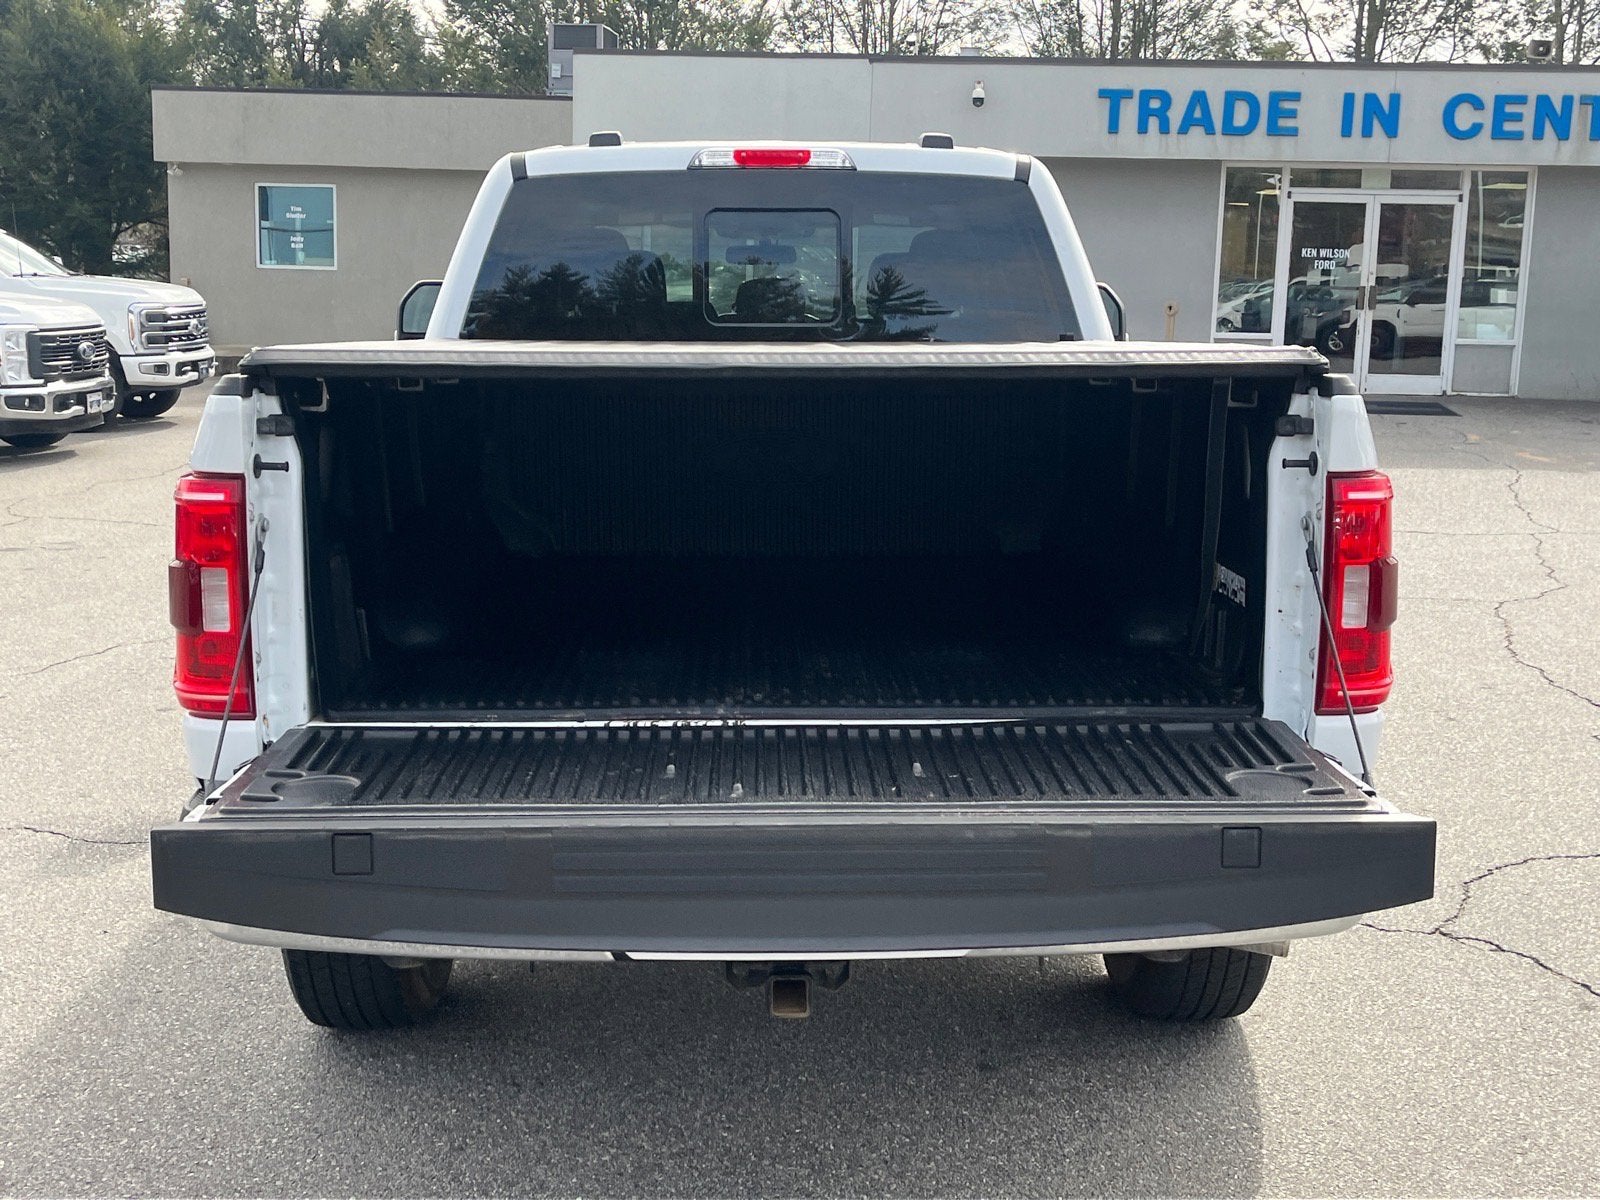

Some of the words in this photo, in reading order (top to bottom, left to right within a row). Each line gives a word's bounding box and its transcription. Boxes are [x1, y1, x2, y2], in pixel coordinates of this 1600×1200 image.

[1098, 88, 1302, 136] TRADE
[1341, 92, 1401, 138] IN
[1442, 93, 1600, 141] CENT
[1301, 247, 1318, 258] KEN
[1319, 248, 1350, 259] WILSON
[1314, 259, 1336, 270] FORD
